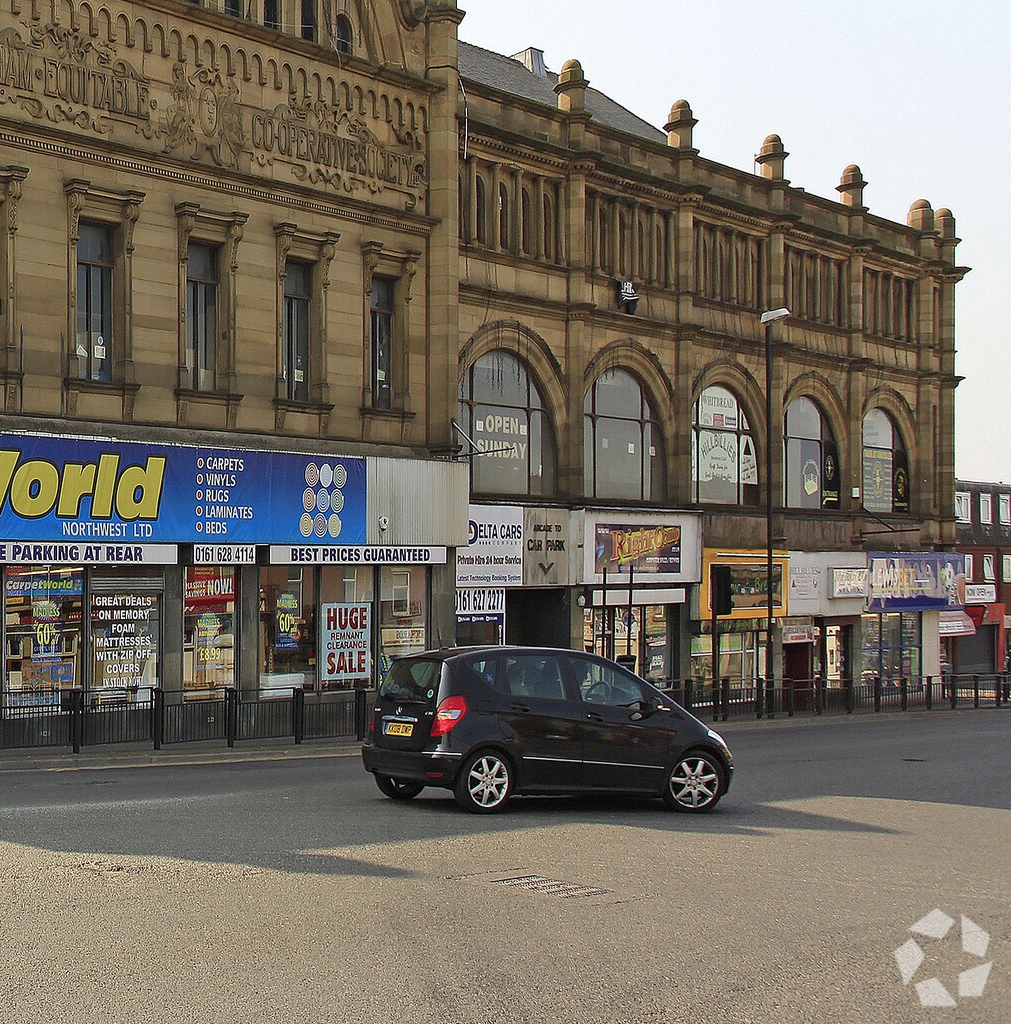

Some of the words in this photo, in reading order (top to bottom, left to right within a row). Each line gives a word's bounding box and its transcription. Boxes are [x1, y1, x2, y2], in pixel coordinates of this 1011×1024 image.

[44, 57, 150, 121] EQUITABLE
[252, 114, 357, 173] CO-OPERATIVE
[357, 141, 413, 188] SOCIETY
[485, 415, 519, 435] OPEN
[476, 438, 526, 459] SUNDAY
[206, 457, 244, 471] CARPETS
[206, 473, 236, 486] VINYLS
[205, 489, 229, 502] RUGS
[205, 506, 253, 519] LAMINATES
[62, 522, 128, 537] NORTHWEST
[133, 523, 153, 538] LTD
[205, 521, 227, 534] BEDS
[500, 524, 522, 540] CARS
[533, 524, 553, 533] ARCADE
[555, 525, 562, 533] TO
[527, 539, 543, 551] CAR
[546, 539, 566, 552] PARK
[11, 545, 79, 561] PARKING
[83, 546, 103, 562] AT
[106, 546, 143, 562] REAR
[195, 547, 215, 562] 0161
[217, 547, 232, 562] 628
[235, 547, 254, 563] 4114
[291, 548, 319, 562] BEST
[322, 548, 360, 563] PRICES
[364, 548, 430, 563] GUARANTEED
[457, 555, 474, 565] Private
[475, 555, 485, 565] Hire
[486, 555, 492, 565] 24
[493, 555, 504, 565] hour
[505, 555, 522, 565] Service
[5, 579, 74, 591] CarpetWorld
[185, 580, 207, 590] MASSIVE
[207, 578, 235, 596] NOW!
[185, 589, 206, 599] SAVINGS
[473, 589, 486, 611] 627
[487, 589, 504, 611] 2277
[95, 596, 124, 606] GREAT
[125, 596, 152, 606] DEALS
[32, 607, 60, 617] MADNESS
[98, 610, 111, 620] ON
[113, 610, 149, 620] MEMORY
[327, 607, 367, 630] HUGE
[111, 623, 135, 634] FOAM
[330, 631, 364, 640] REMNANT
[326, 640, 367, 650] CLEARANCE
[96, 651, 118, 661] WITH
[120, 650, 134, 660] ZIP
[136, 649, 152, 659] OFF
[199, 647, 221, 661] £8.99
[106, 664, 140, 674] COVERS
[327, 651, 367, 675] SALE
[109, 677, 128, 688] STOCK
